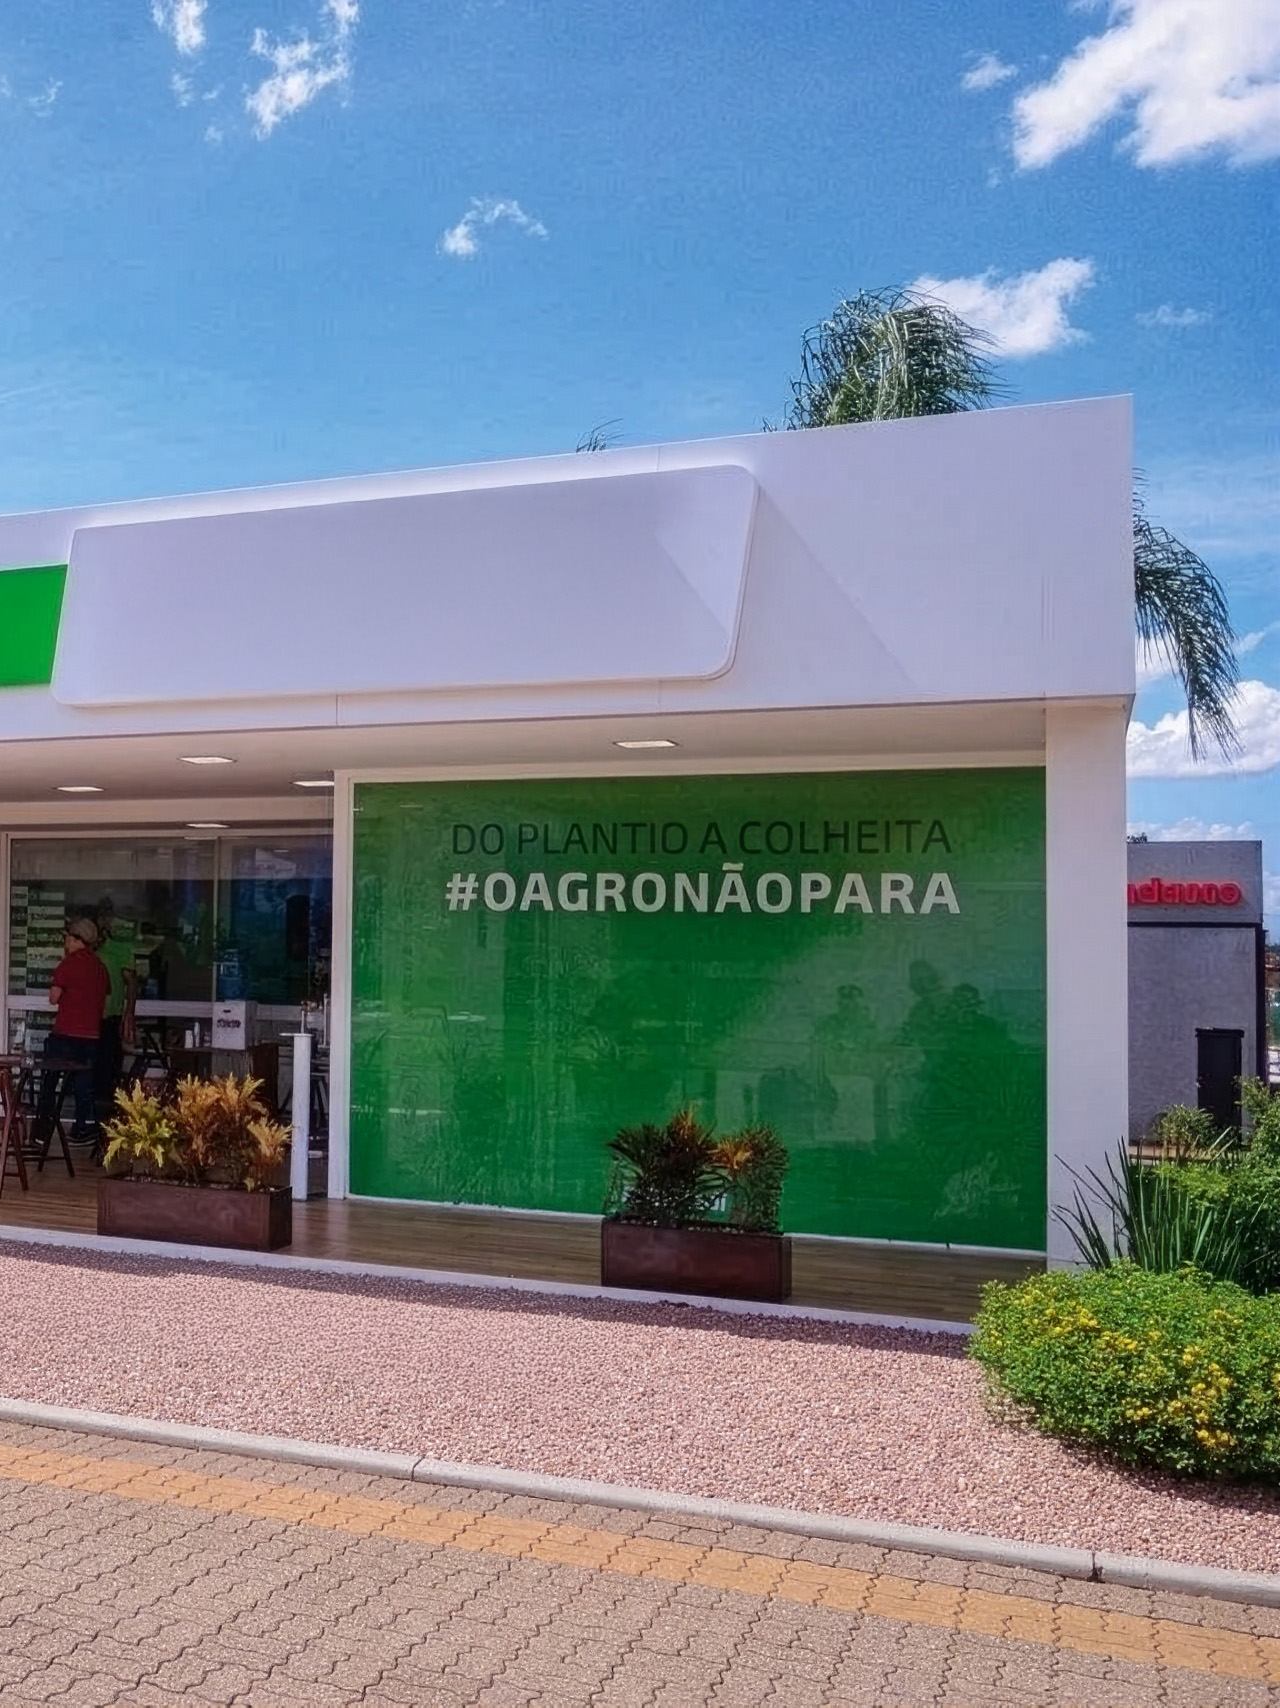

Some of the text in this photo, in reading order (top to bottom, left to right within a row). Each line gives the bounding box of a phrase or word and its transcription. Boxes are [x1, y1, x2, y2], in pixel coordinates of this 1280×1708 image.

[451, 818, 953, 855] DO PLANTIO A COLHEITA
[446, 862, 961, 914] #OAGRONÃOPARA
